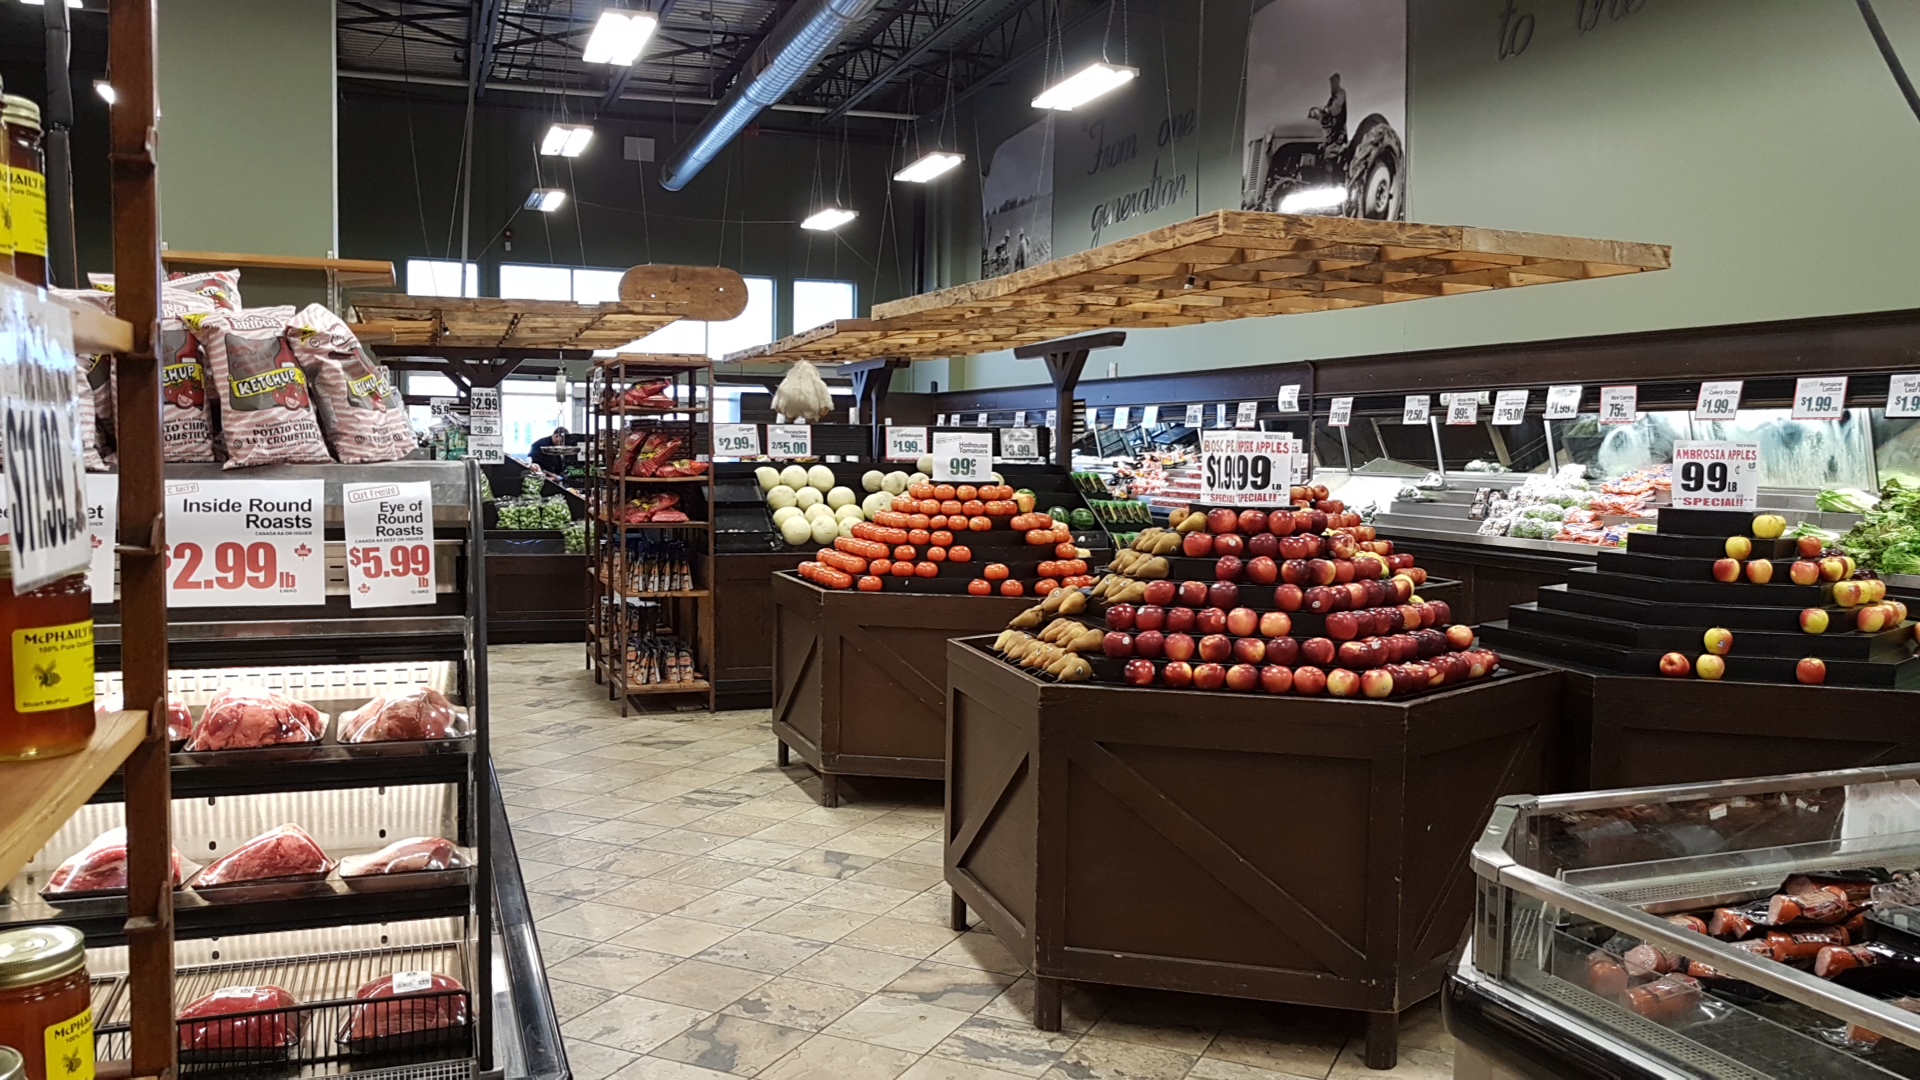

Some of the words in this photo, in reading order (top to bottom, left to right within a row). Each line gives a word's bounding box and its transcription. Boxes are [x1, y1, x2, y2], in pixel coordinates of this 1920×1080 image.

[234, 317, 280, 331] BRIDGE
[236, 368, 297, 396] KETCHUP
[431, 404, 449, 415] $5.9
[472, 397, 498, 410] $2.99
[1702, 398, 1729, 413] $1.99
[1801, 395, 1832, 412] $1.99
[1894, 395, 1920, 412] $1.9
[253, 425, 292, 437] POTATO
[474, 426, 494, 434] $3.99
[718, 436, 749, 451] $2.99
[771, 441, 807, 454] 2/$5.00
[893, 440, 918, 452] $1.99
[958, 441, 989, 449] Hothouse
[1004, 444, 1030, 456] $3.99
[1203, 439, 1224, 453] BOSC
[1256, 441, 1290, 454] APPLES
[1675, 448, 1726, 460] AMBROSIA
[1727, 449, 1757, 461] APPLES
[352, 490, 369, 501] Cut
[369, 486, 396, 498] Fresh!
[1271, 483, 1282, 491] LB
[1727, 481, 1738, 493] LB
[183, 498, 242, 513] Inside
[249, 498, 313, 513] Round
[379, 501, 405, 515] Eye
[409, 500, 424, 511] of
[246, 513, 313, 530] Roasts
[377, 512, 423, 525] Round
[375, 525, 424, 537] Roasts
[348, 544, 431, 580] $5.99
[279, 571, 296, 589] lb
[418, 576, 429, 588] lb
[61, 643, 76, 651] Pure
